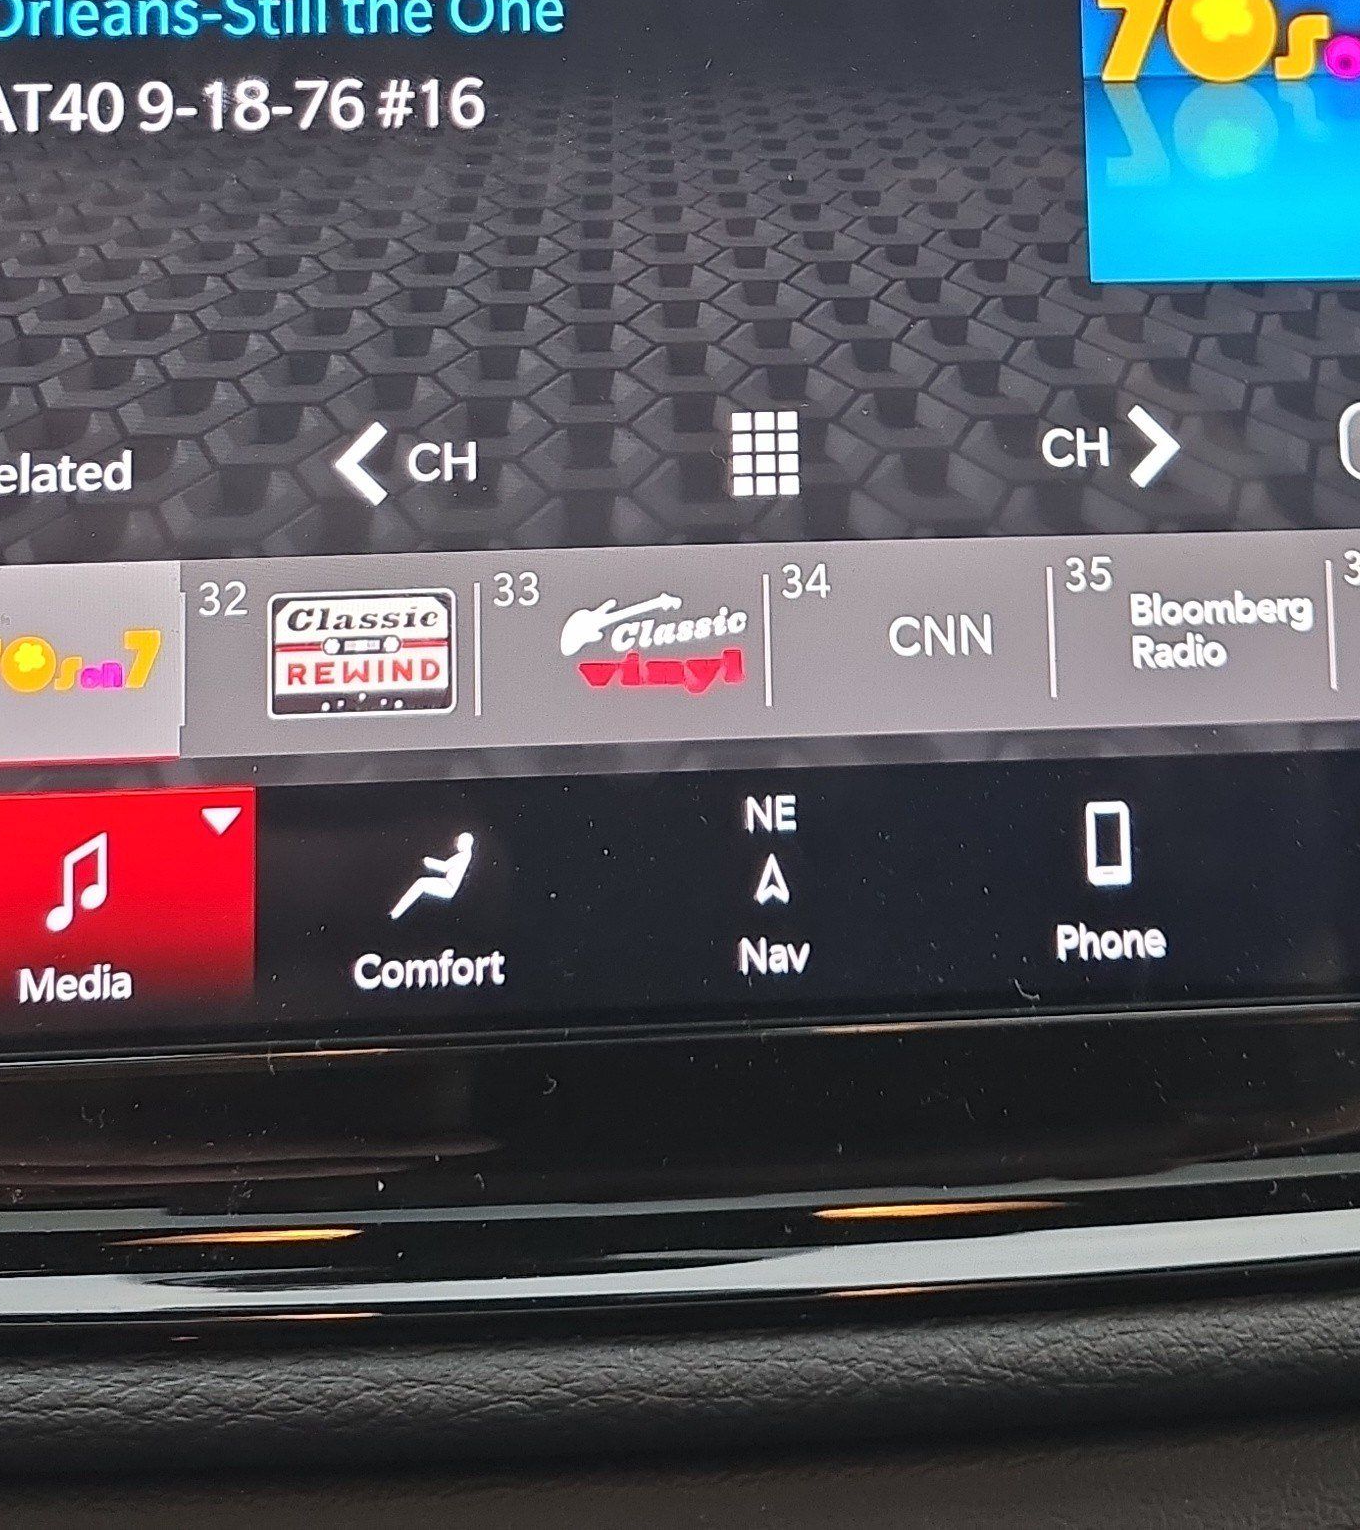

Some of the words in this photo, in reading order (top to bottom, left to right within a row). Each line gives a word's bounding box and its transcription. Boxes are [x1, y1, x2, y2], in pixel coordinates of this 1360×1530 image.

[139, 79, 364, 131] 9-18-76
[379, 78, 486, 129] #16
[407, 442, 478, 483] CH
[1041, 428, 1109, 468] CH
[493, 572, 540, 606] 33
[781, 564, 831, 600] 34
[1065, 557, 1113, 591] 35
[198, 581, 248, 616] 32
[1131, 592, 1313, 631] Bloomberg
[288, 607, 438, 631] Classic
[611, 607, 747, 651] Classic
[888, 615, 992, 657] CNN
[1131, 634, 1227, 668] Radio
[288, 659, 440, 685] REWIND
[745, 795, 797, 832] NE
[739, 939, 810, 974] Nav
[1056, 924, 1167, 960] Phone
[18, 965, 132, 1003] Media
[353, 950, 506, 991] Comfort
